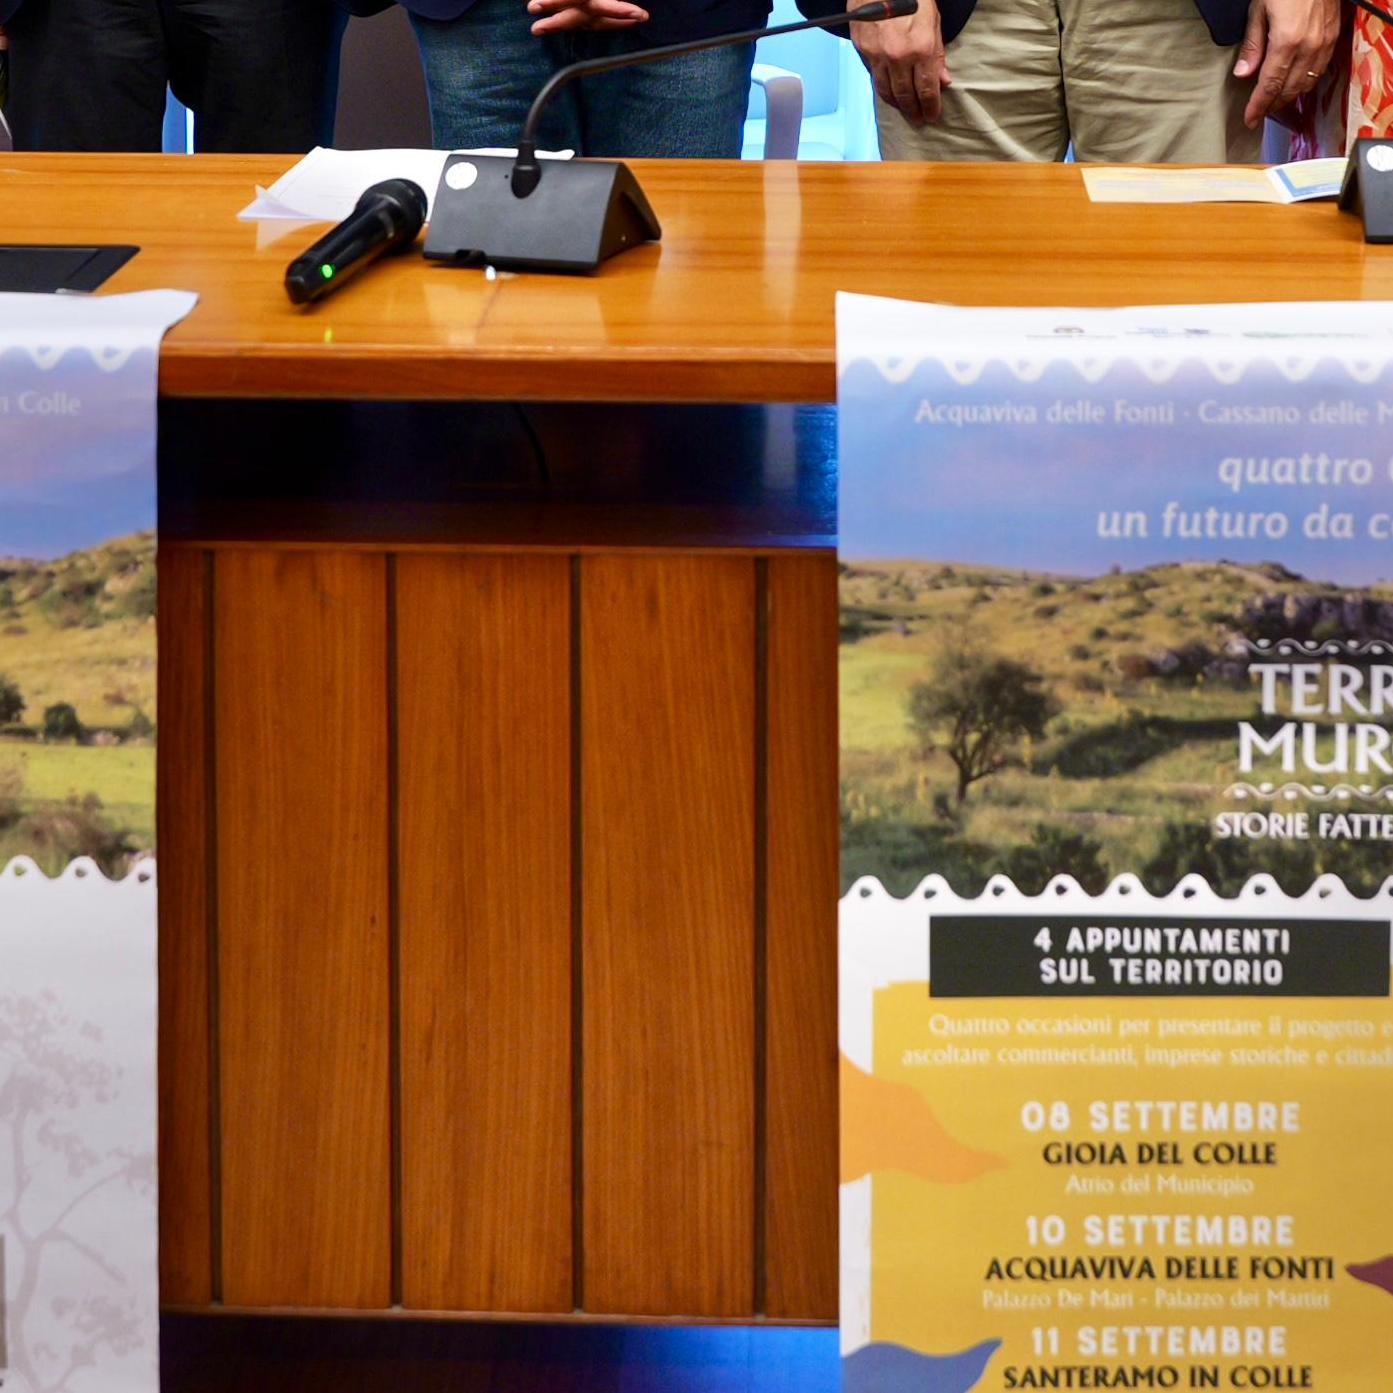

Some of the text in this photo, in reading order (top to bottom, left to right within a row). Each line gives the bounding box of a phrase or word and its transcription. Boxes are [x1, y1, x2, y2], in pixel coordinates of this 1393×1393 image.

[18, 390, 81, 415] Colle
[915, 399, 1037, 426] Acquaviva
[1046, 400, 1105, 424] delle
[1113, 400, 1174, 424] Fonti
[1198, 400, 1300, 425] Cassano
[1308, 400, 1368, 425] delle
[1218, 454, 1373, 491] quattro
[1097, 513, 1148, 538] un
[1162, 502, 1288, 538] futuro
[1303, 505, 1354, 539] da
[1214, 812, 1309, 840] STORIE
[1033, 927, 1290, 955] 4 APPUNTAMENTI
[1039, 958, 1284, 985] SUL TERRITORIO
[928, 1015, 1393, 1041] Quattro occasioni per presentare il progetto e
[902, 1044, 991, 1065] ascoltare
[997, 1044, 1137, 1067] commercianti,
[1144, 1045, 1223, 1069] imprese
[1229, 1044, 1310, 1066] storiche
[1316, 1051, 1327, 1065] e
[1021, 1101, 1300, 1132] 08 SETTEMBRE
[1042, 1142, 1277, 1167] GIOIA DEL COLLE
[1065, 1174, 1254, 1197] Atrio del Municipio
[1026, 1215, 1294, 1246] 10 SETTEMBRE
[986, 1256, 1334, 1282] ACQUAVIVA DELLE FONTI
[982, 1289, 1330, 1309] Palazzo De Mari Palazzo dei Martiri
[1031, 1326, 1286, 1357] 11 SETTEMBRE
[1004, 1364, 1312, 1390] SANTERAMO IN COLLE
